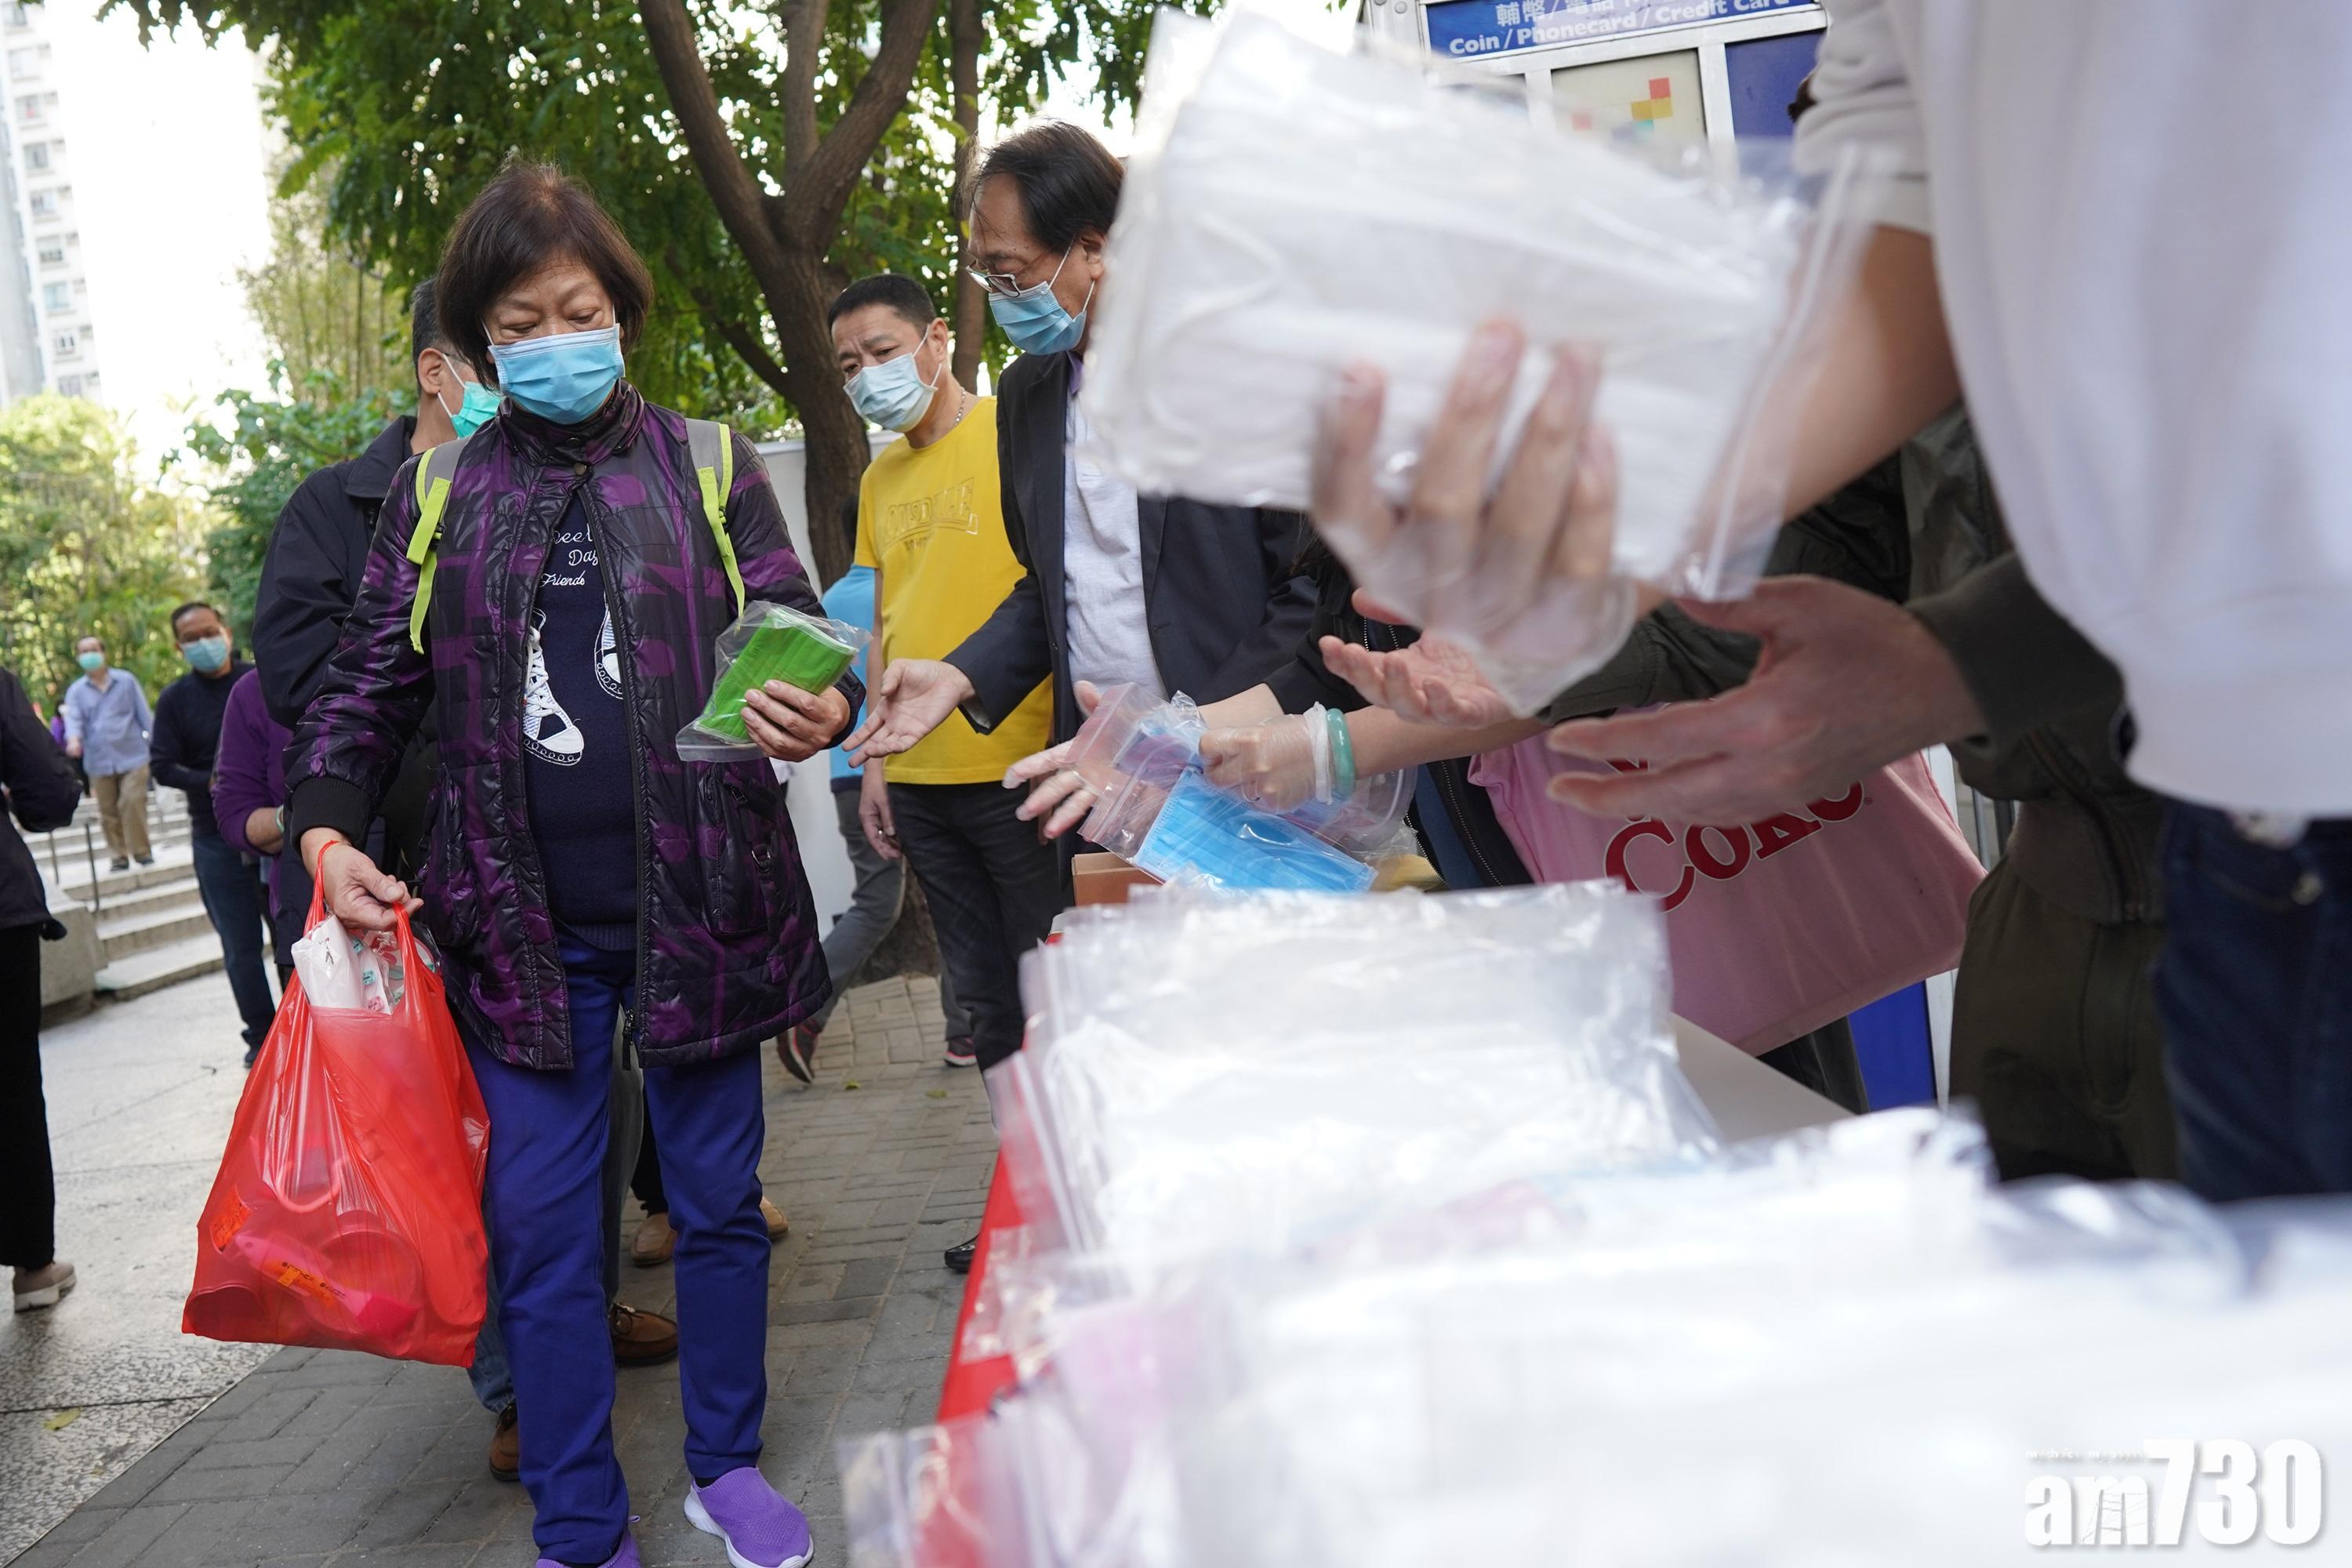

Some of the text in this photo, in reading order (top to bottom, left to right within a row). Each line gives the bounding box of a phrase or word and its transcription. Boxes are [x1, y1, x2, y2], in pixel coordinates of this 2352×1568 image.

[1450, 34, 1499, 54] Coin
[1517, 11, 1637, 45] Phonecard
[1655, 0, 1727, 22] Credit
